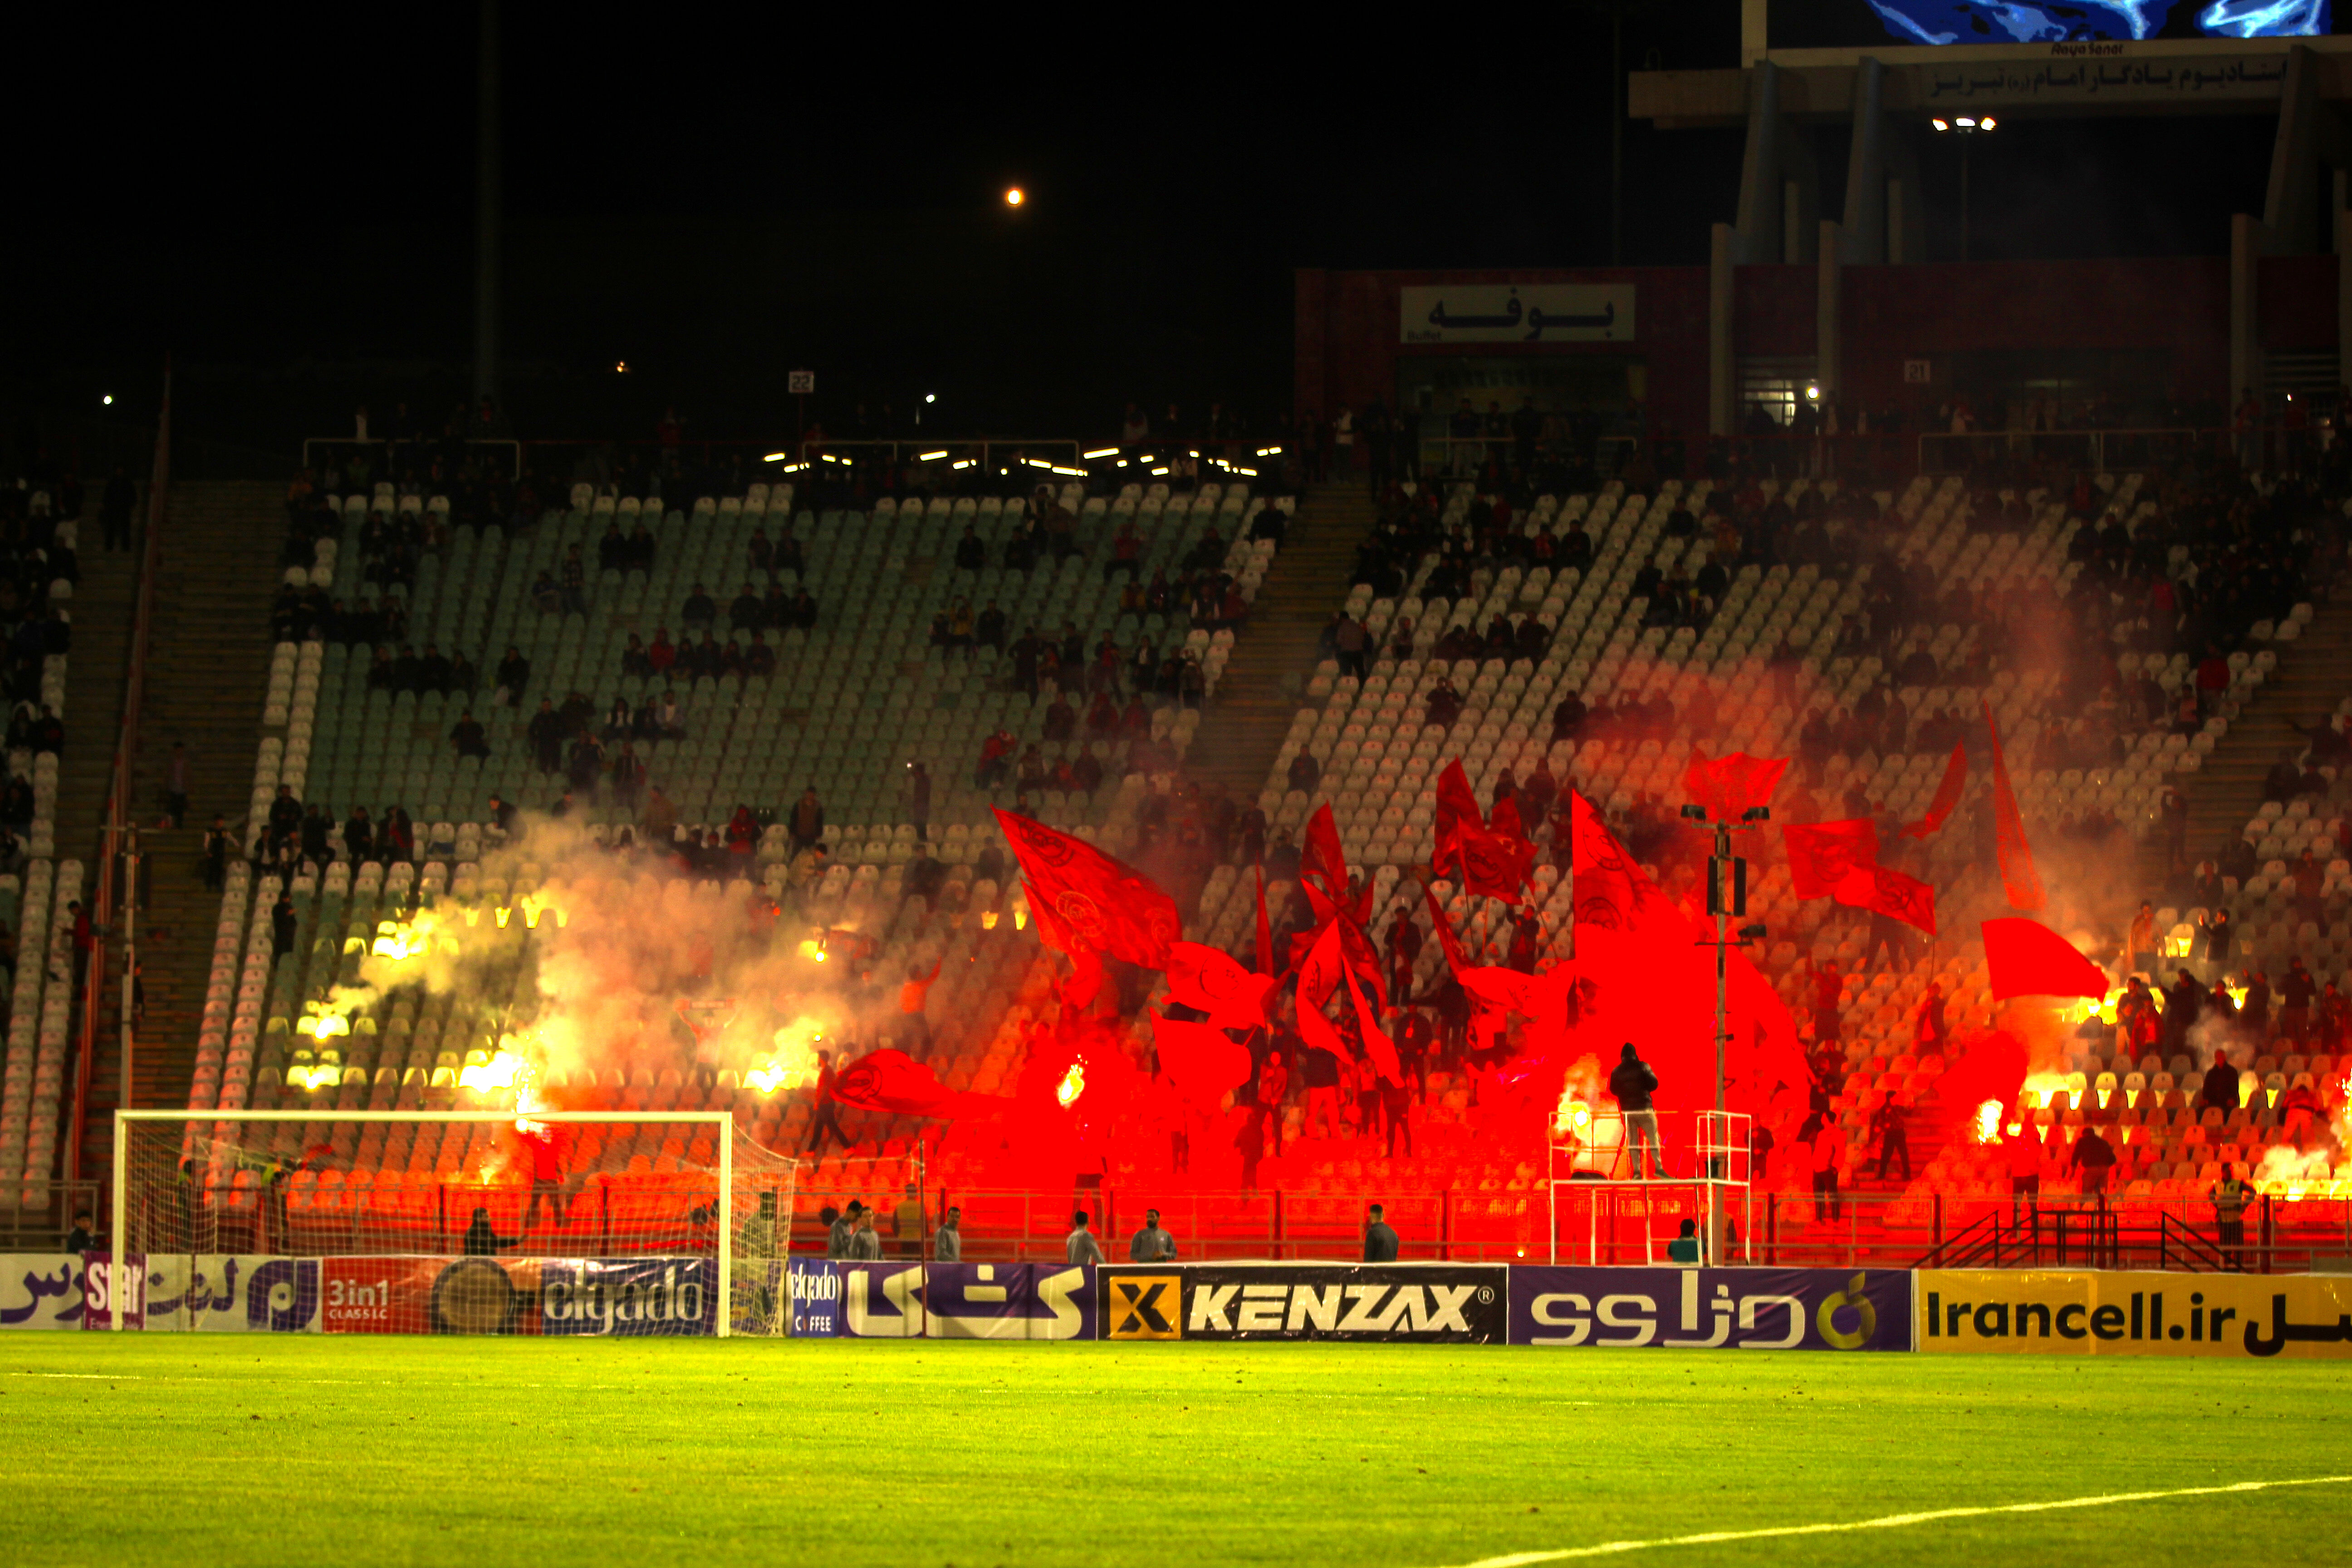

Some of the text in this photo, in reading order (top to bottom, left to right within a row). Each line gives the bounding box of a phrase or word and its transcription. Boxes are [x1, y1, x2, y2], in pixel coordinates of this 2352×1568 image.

[1428, 286, 1614, 340] بوفه
[329, 1279, 389, 1306] 3in1
[329, 1309, 388, 1320] CLASSIC
[545, 1260, 703, 1334] elgado
[1188, 1284, 1478, 1332] KENZAX
[1927, 1292, 2235, 1342] Irancell.ir
